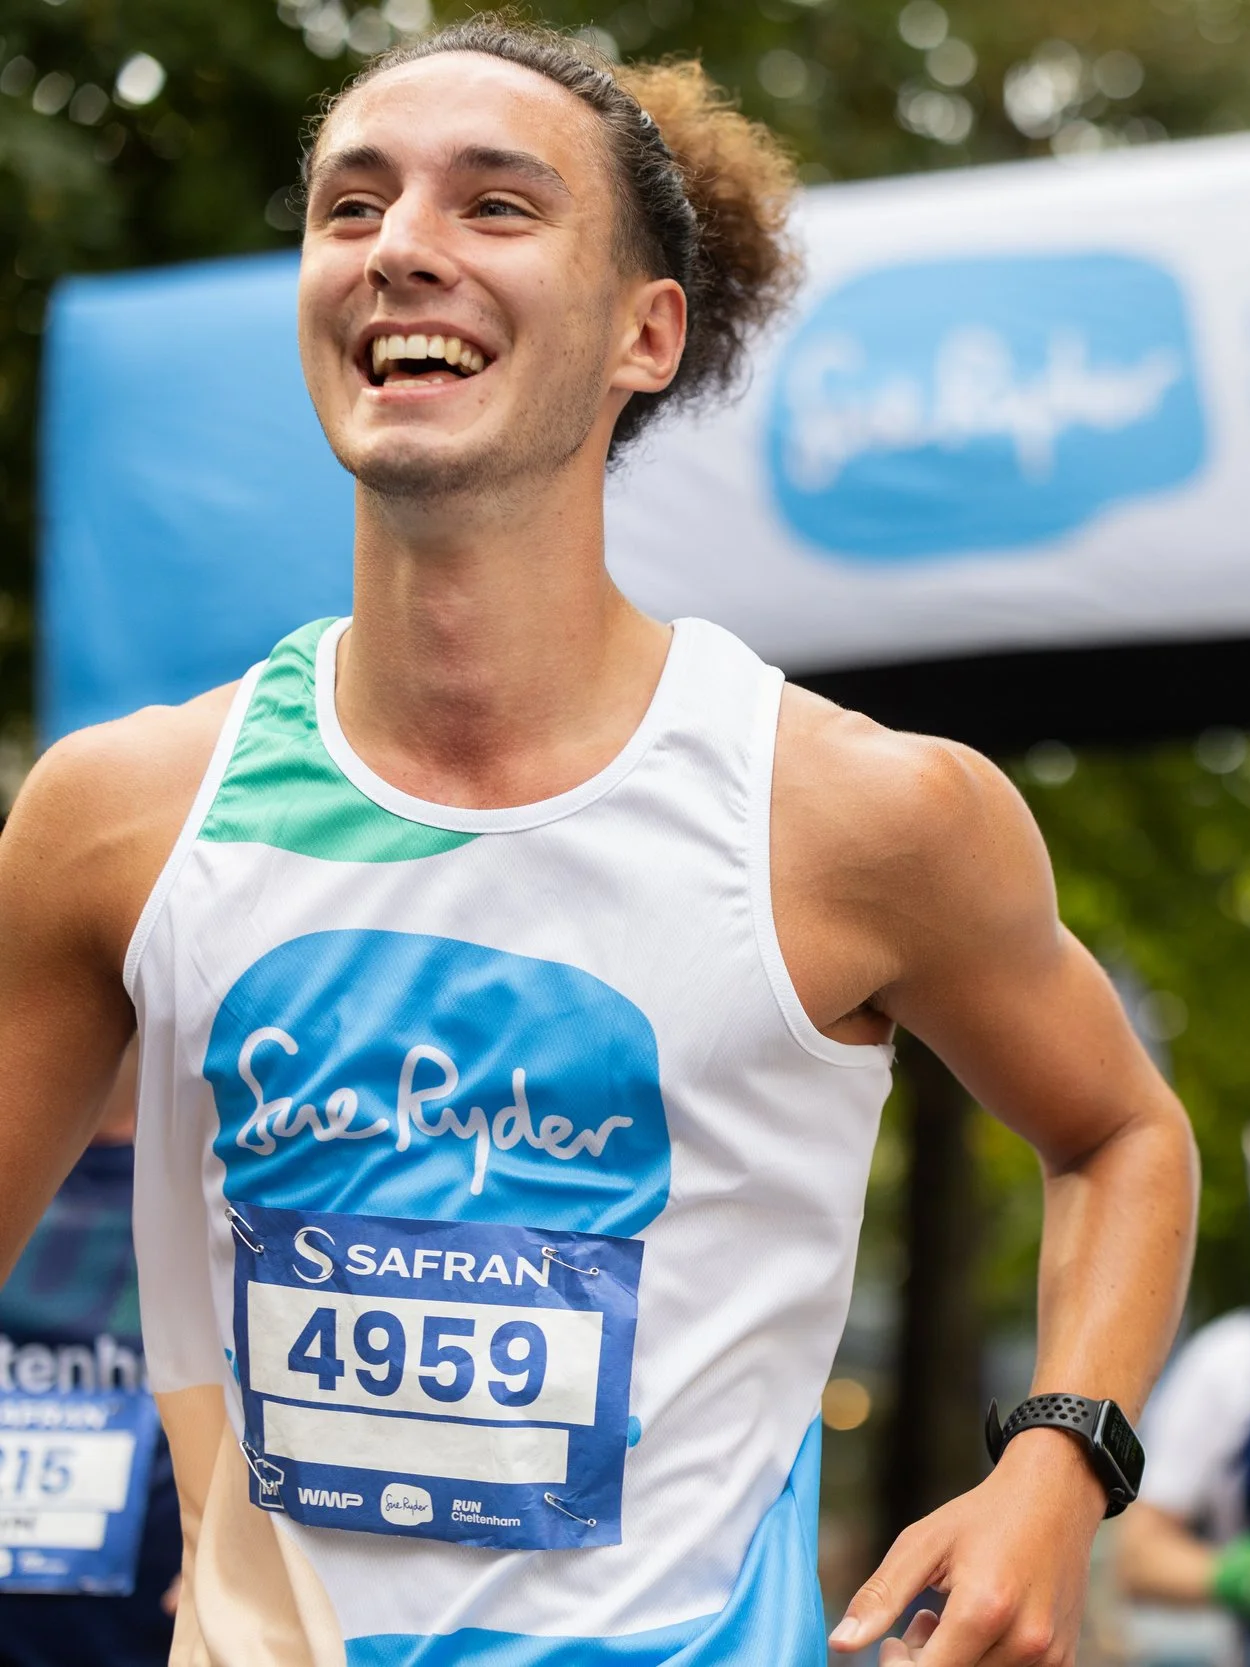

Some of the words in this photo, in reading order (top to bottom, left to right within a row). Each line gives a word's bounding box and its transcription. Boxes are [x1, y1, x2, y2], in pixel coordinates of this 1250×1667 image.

[235, 1026, 388, 1156] Sue
[396, 1044, 634, 1196] Ryder
[345, 1244, 550, 1288] SAFRAN
[0, 1332, 148, 1395] tenh
[287, 1306, 548, 1408] 4959
[0, 1446, 74, 1494] 15
[297, 1487, 363, 1509] WMP
[385, 1493, 402, 1510] Sue
[402, 1499, 431, 1517] Ryder
[451, 1511, 521, 1528] Cheltenham
[452, 1498, 482, 1514] RUN
